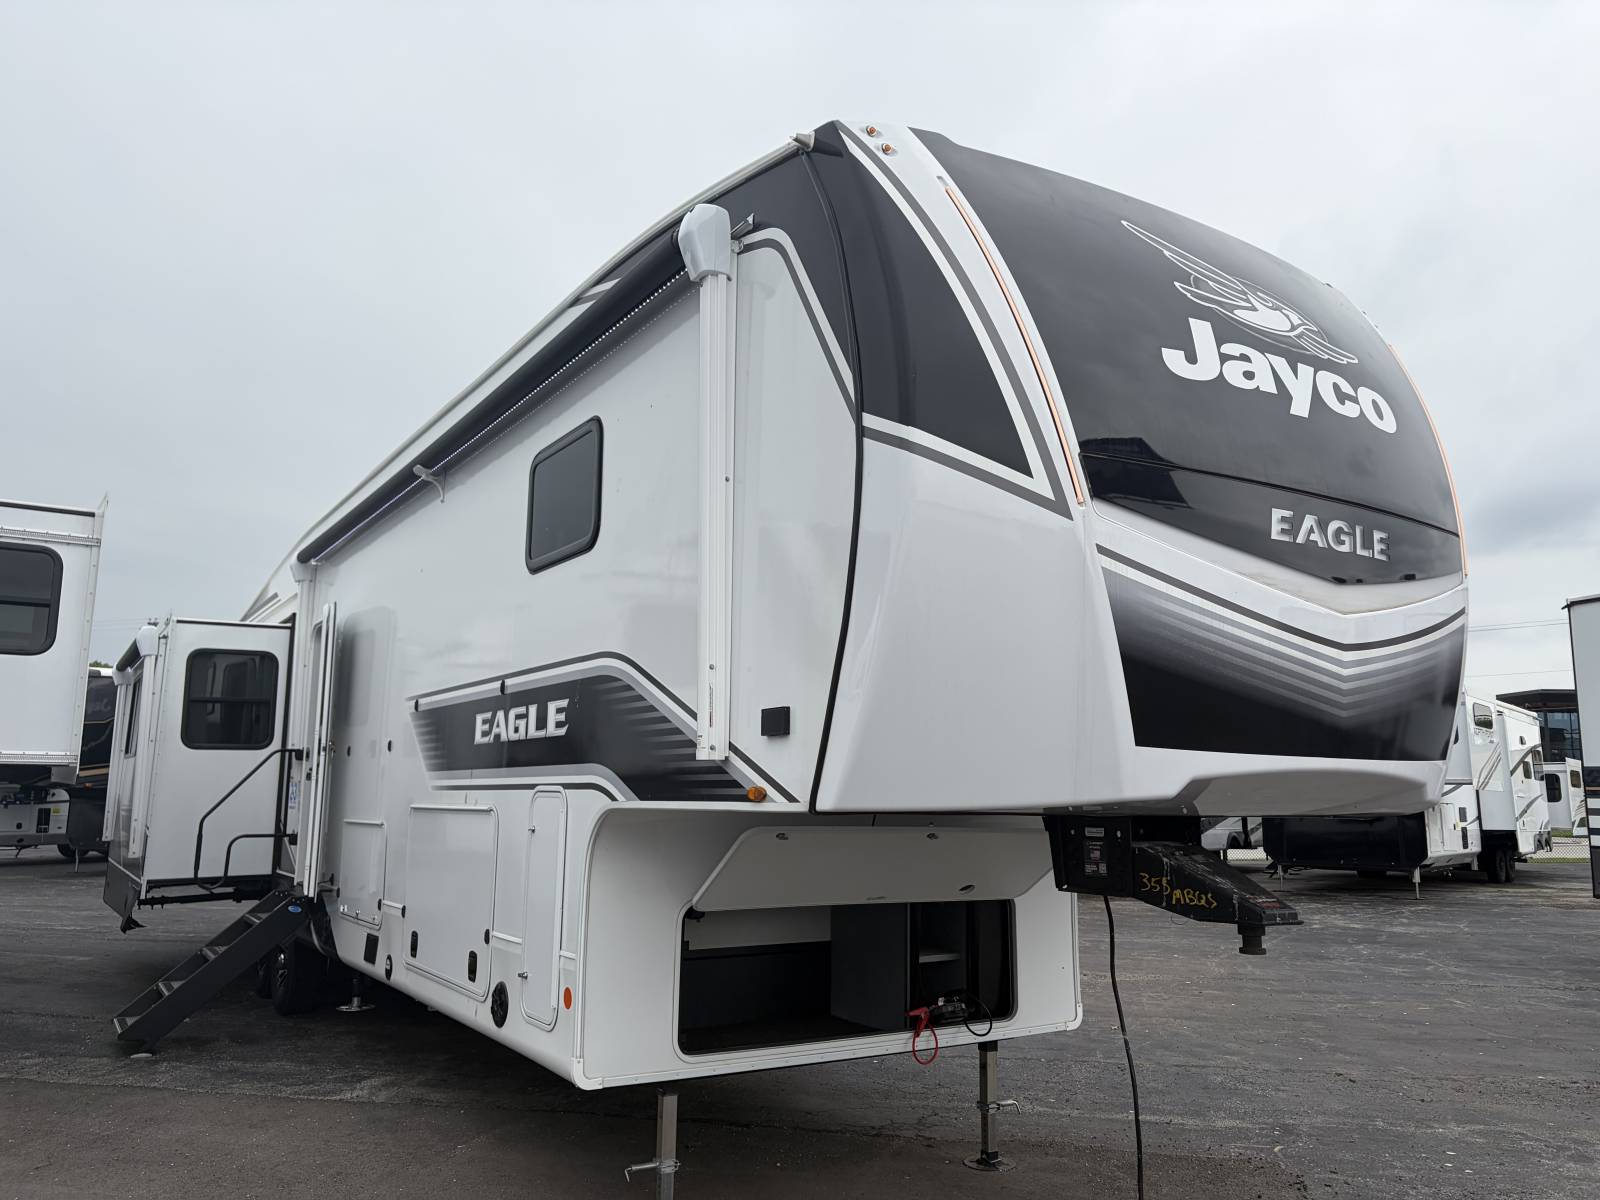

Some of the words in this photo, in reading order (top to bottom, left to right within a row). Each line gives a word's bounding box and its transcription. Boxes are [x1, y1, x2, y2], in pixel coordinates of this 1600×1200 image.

[1161, 317, 1398, 434] Jayco
[1271, 508, 1391, 562] EAGLE
[474, 698, 570, 745] EAGLE
